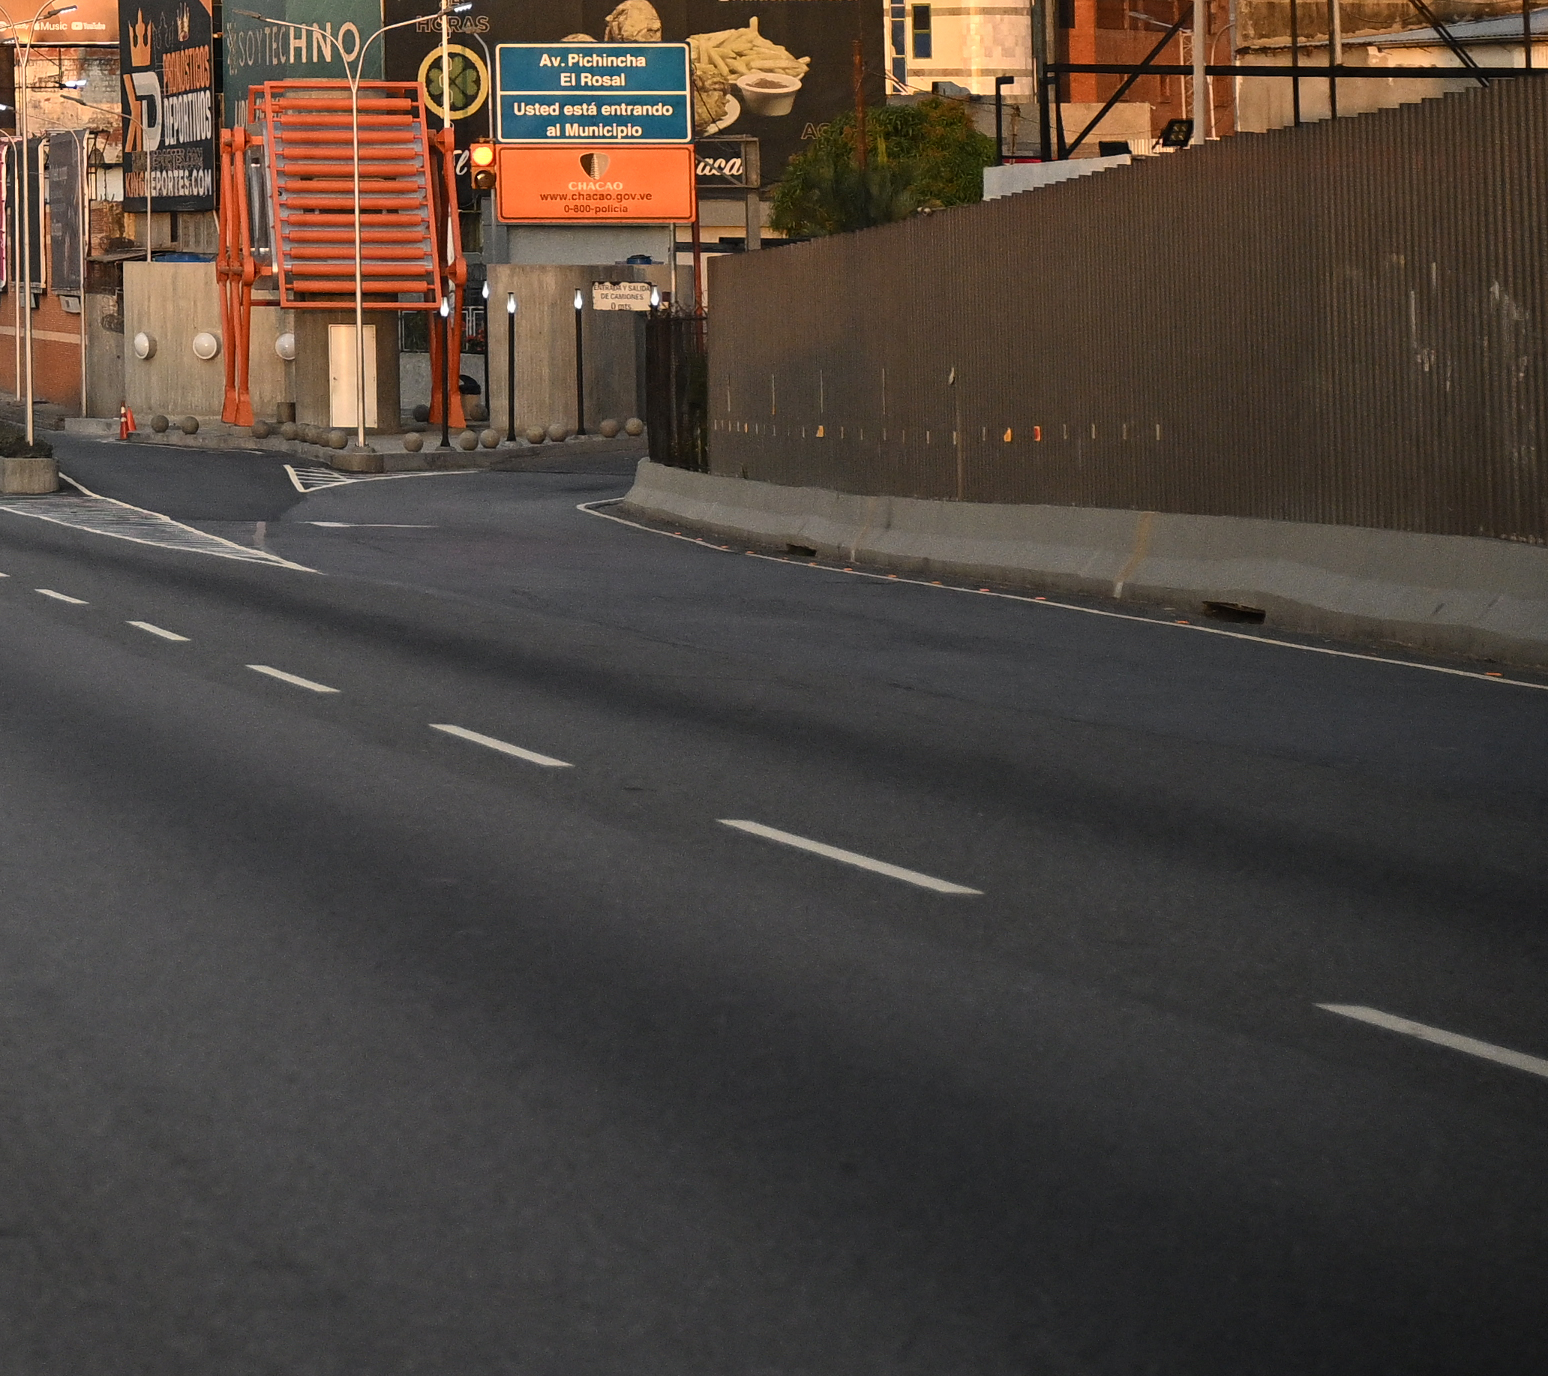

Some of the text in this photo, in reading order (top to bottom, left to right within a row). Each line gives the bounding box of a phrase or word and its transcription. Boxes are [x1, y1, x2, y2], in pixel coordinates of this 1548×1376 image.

[40, 21, 68, 31] Music
[415, 16, 490, 33] HORAS
[238, 21, 361, 67] SOYTECHNO
[539, 53, 646, 68] Av. Pichincha
[560, 72, 626, 87] El Rosal
[513, 101, 673, 116] Usted está entrando
[164, 90, 212, 147] DEPORTIVOS
[546, 122, 643, 140] al Municipio
[125, 168, 212, 198] KINGDEPORTES.COM
[568, 181, 624, 191] CHACAO
[539, 191, 653, 203] www.chacao.gov.ve
[601, 292, 610, 300] DE
